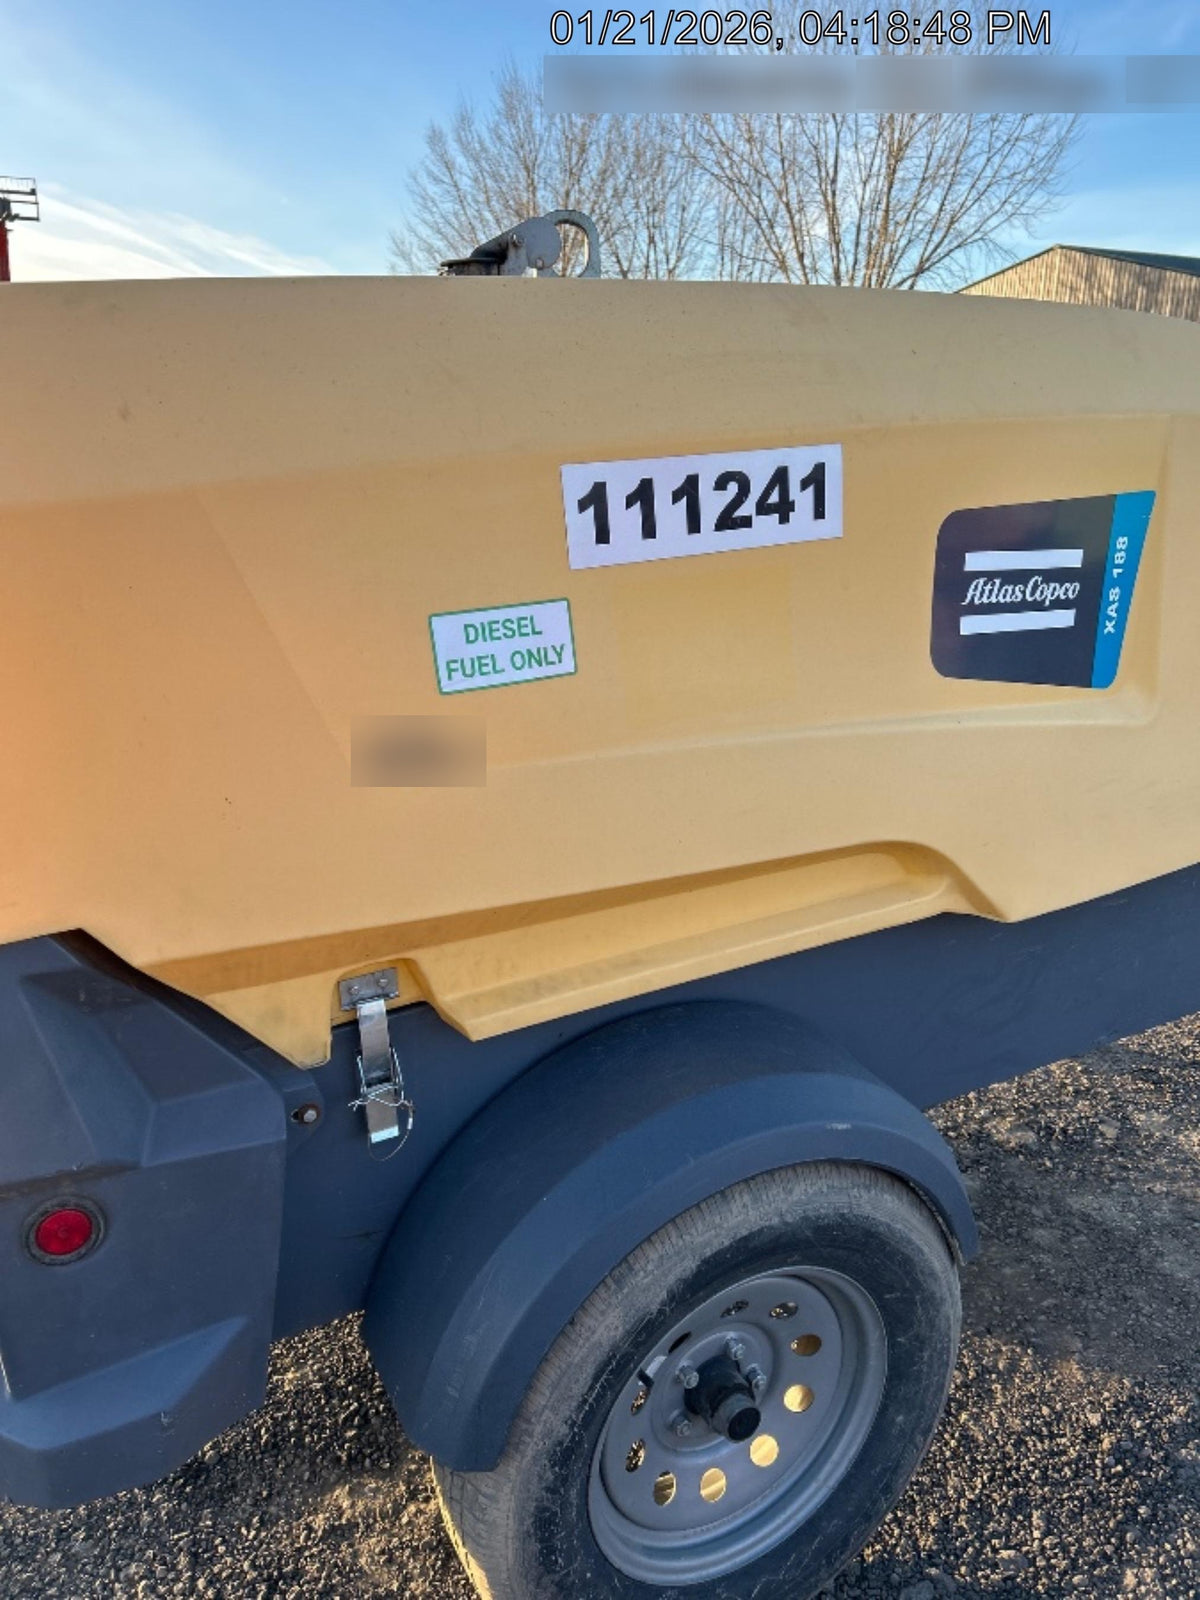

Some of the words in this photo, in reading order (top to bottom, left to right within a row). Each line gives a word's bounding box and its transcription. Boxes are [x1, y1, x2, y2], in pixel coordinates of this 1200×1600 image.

[577, 462, 826, 545] 111241
[1112, 536, 1128, 578] 188
[463, 615, 543, 645] DIESEL
[1104, 586, 1121, 634] XAS
[445, 652, 505, 681] FUEL
[510, 644, 565, 671] ONLY
